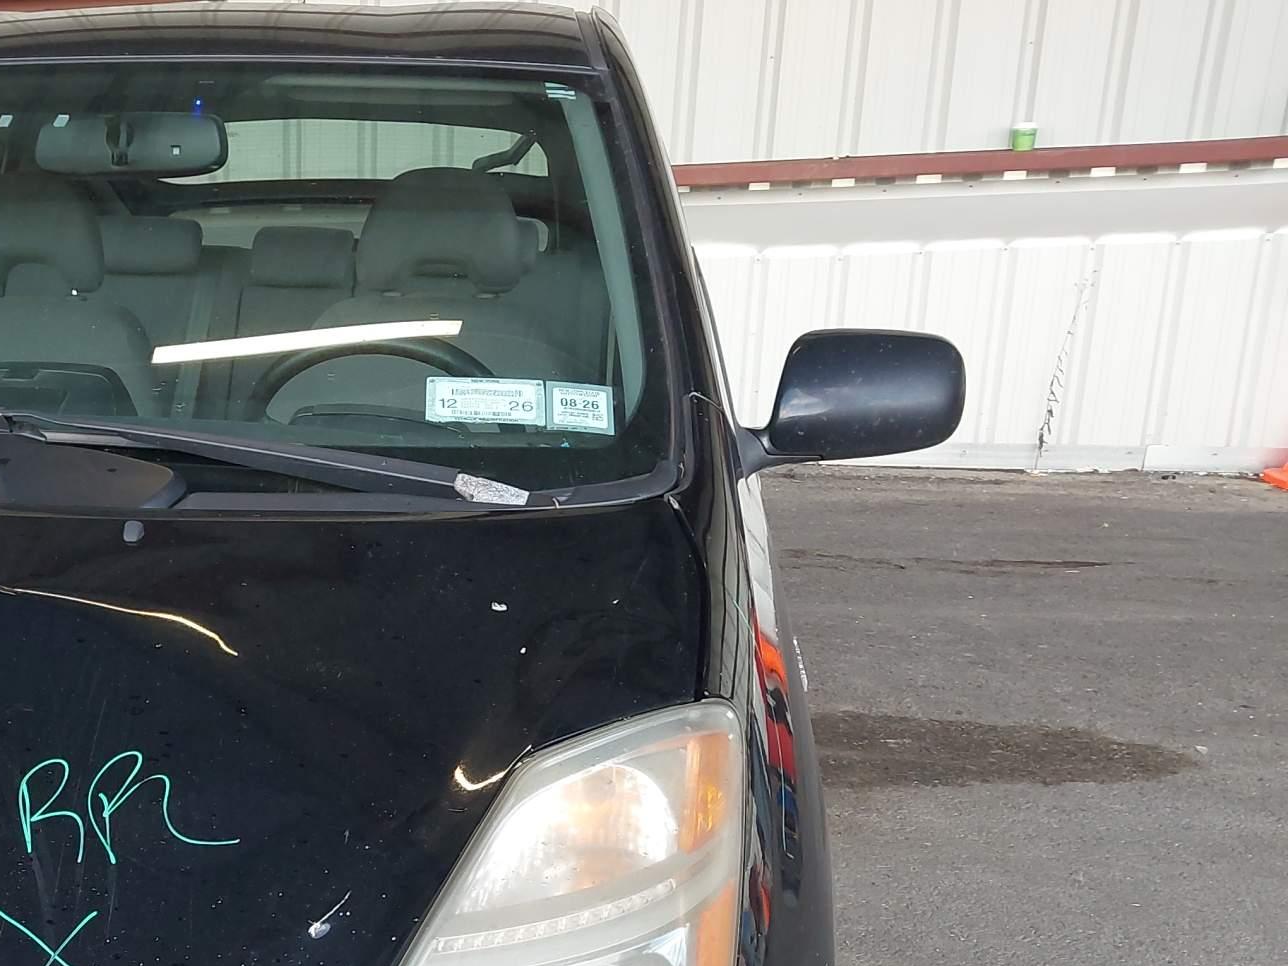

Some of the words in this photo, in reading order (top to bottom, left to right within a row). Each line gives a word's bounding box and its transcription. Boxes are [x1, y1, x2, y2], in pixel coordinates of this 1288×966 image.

[438, 397, 458, 409] 12
[508, 400, 534, 412] 26
[560, 397, 600, 410] 08-26
